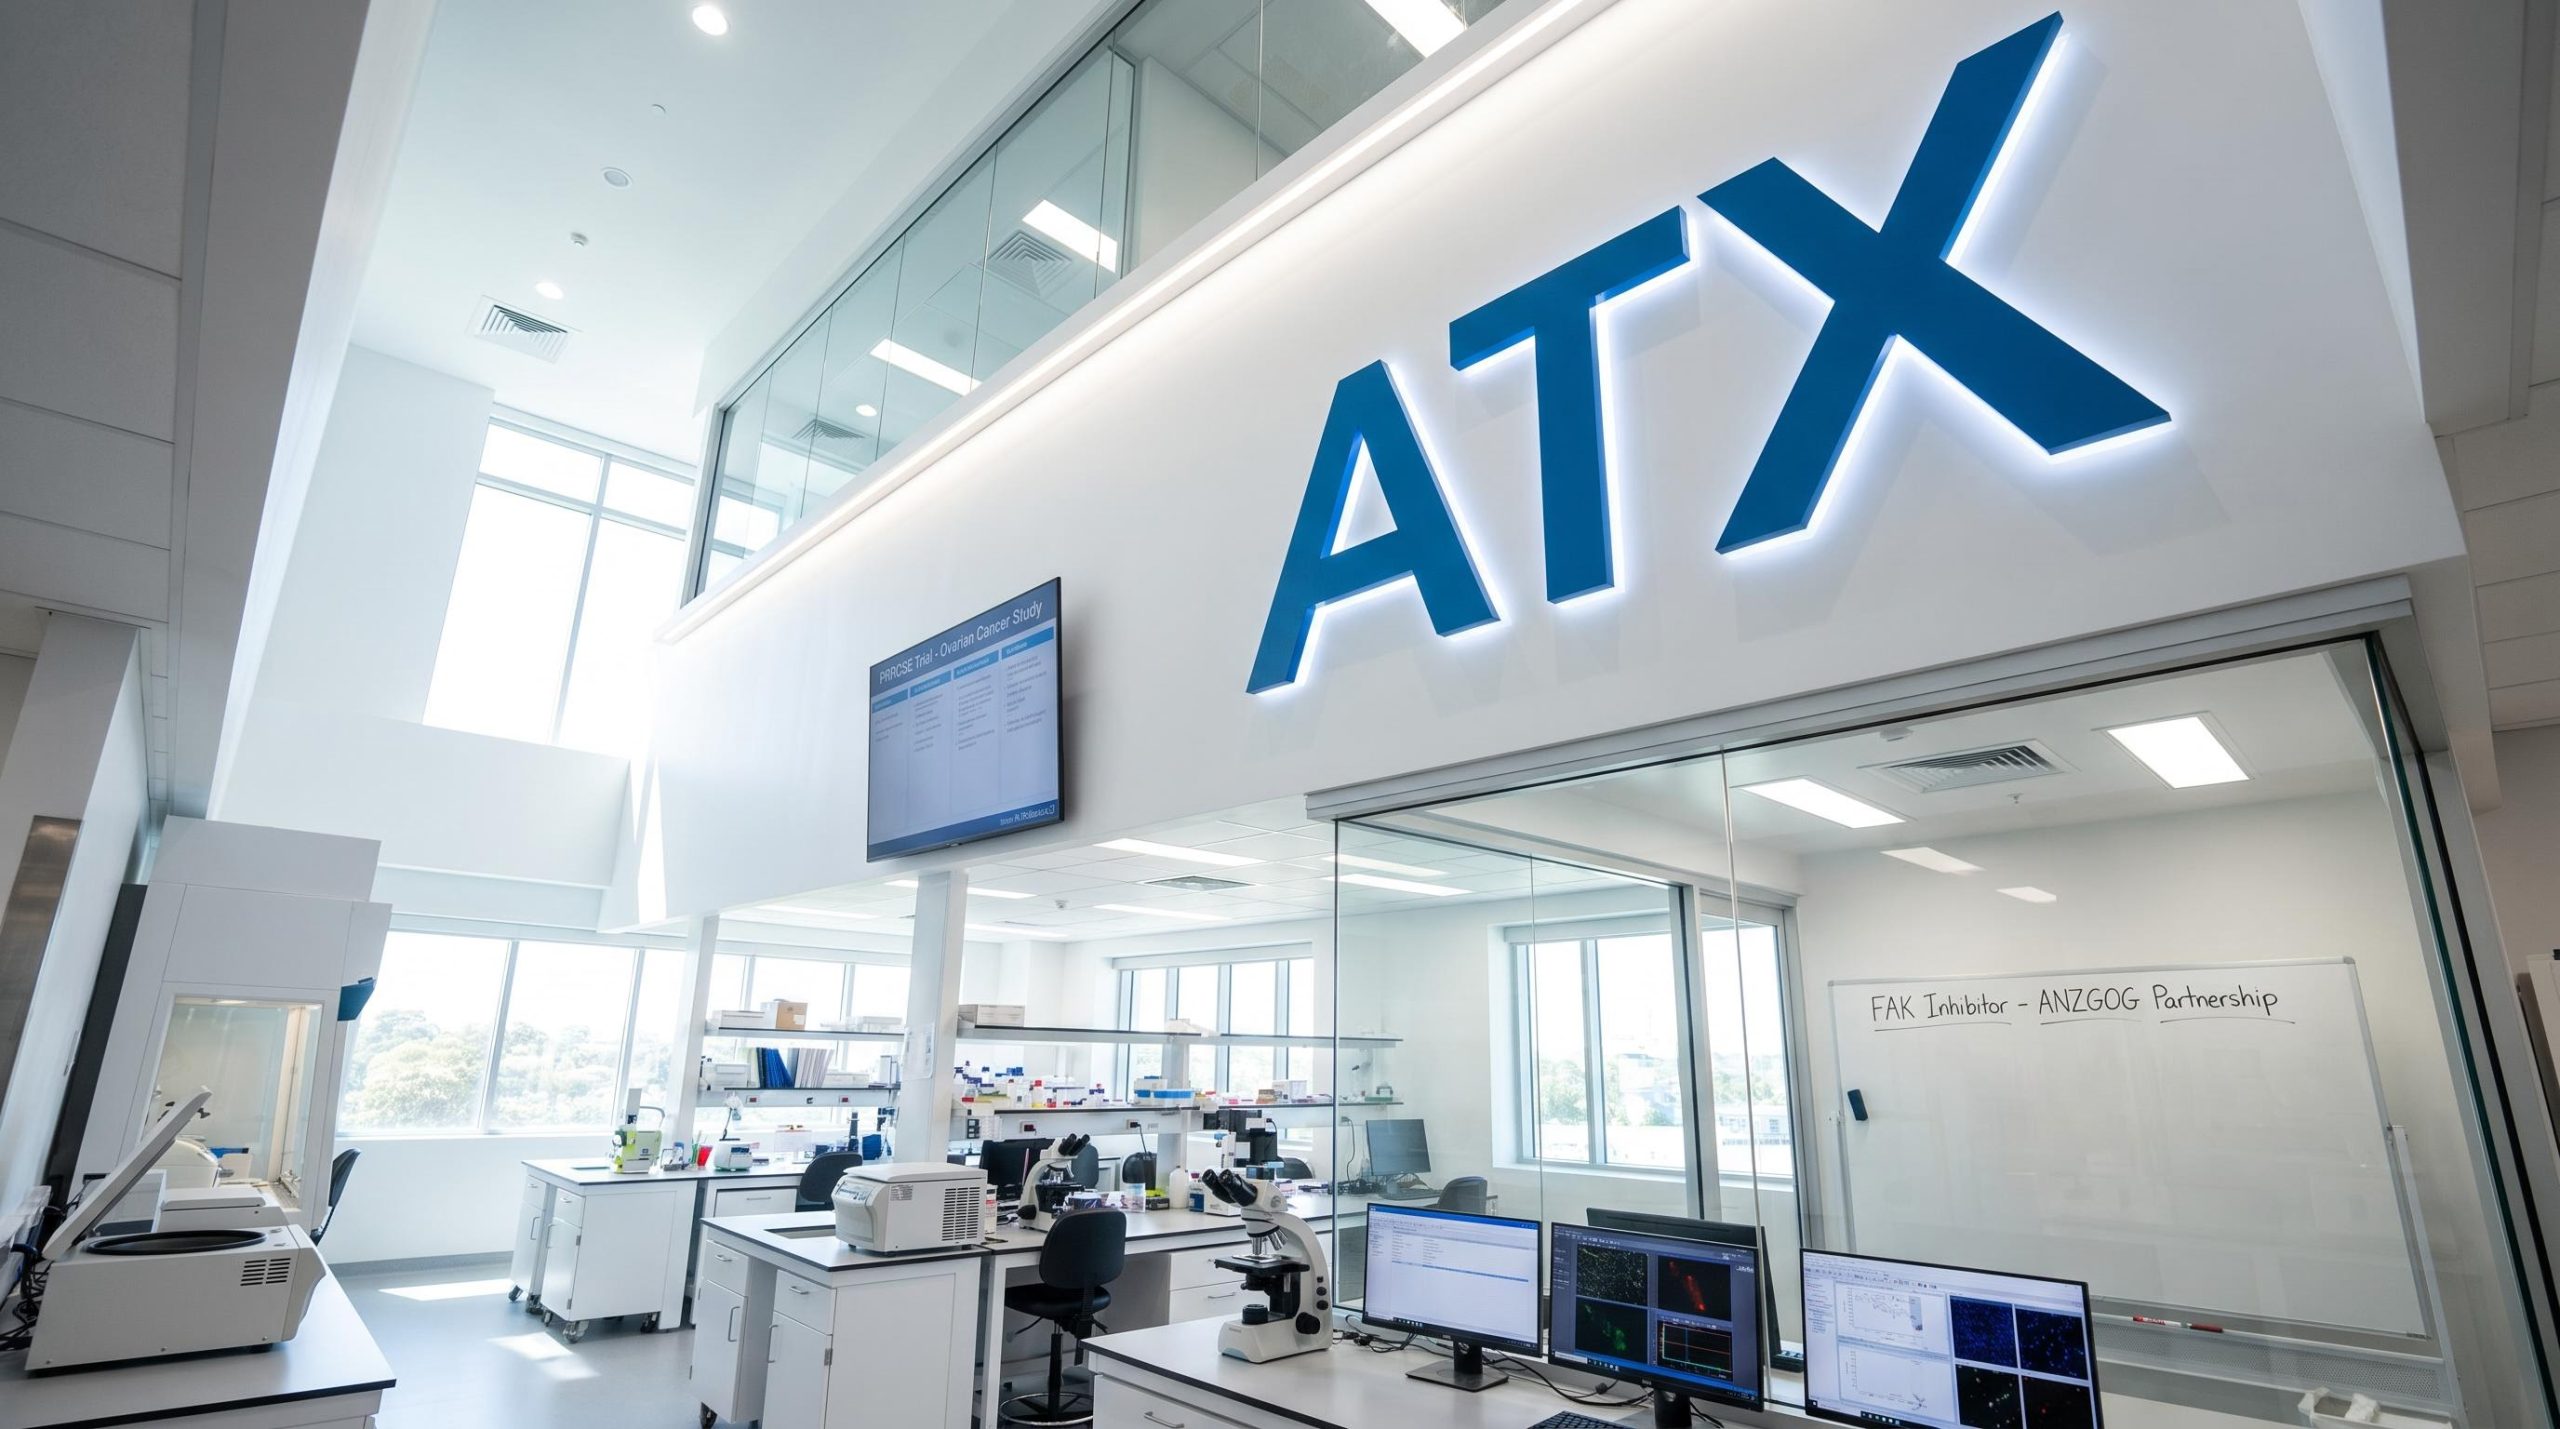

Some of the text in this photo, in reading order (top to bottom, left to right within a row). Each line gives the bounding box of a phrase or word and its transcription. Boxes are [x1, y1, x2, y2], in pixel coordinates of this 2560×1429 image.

[1246, 10, 2171, 695] ATX
[914, 647, 933, 669] Trial
[940, 634, 974, 657] Ovarian
[976, 615, 1010, 641] Cancer
[1012, 600, 1043, 625] Study
[1871, 995, 1915, 1021] FAK
[1924, 992, 2008, 1018] Inhibitor
[2039, 986, 2140, 1015] ANZGOG
[2152, 984, 2278, 1016] Partnership
